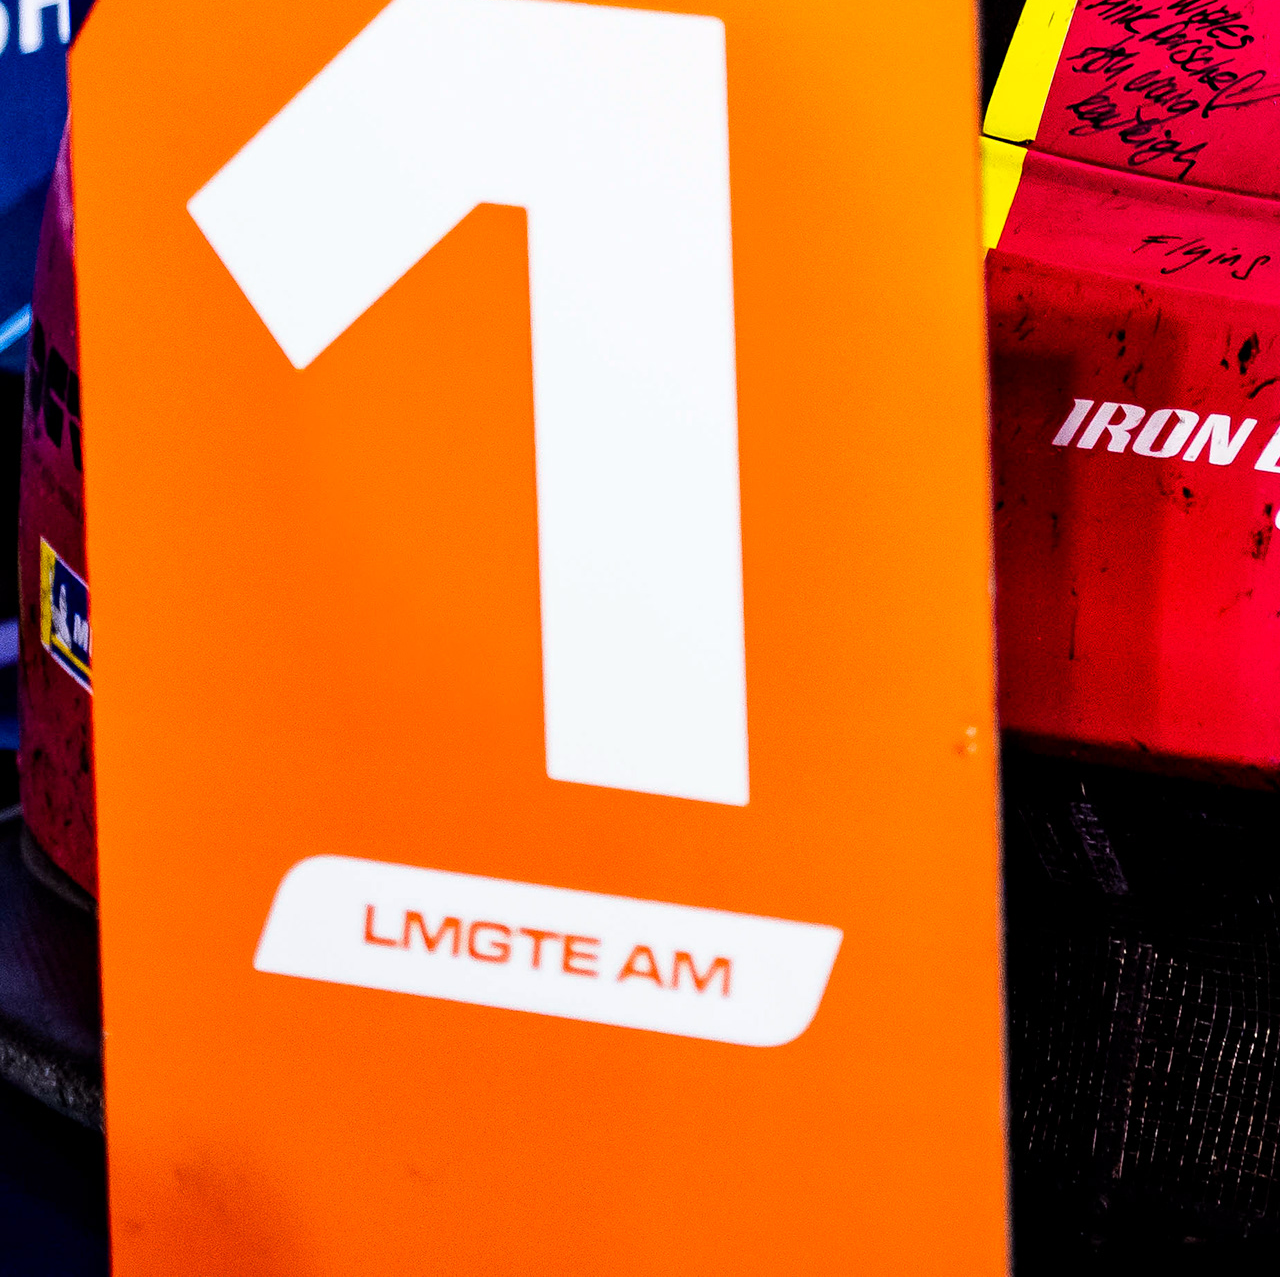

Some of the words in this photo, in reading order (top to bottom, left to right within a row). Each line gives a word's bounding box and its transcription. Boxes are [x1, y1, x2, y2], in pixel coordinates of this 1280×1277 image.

[1052, 398, 1258, 466] IRON
[362, 902, 602, 976] LMGTE
[617, 951, 734, 999] AM
